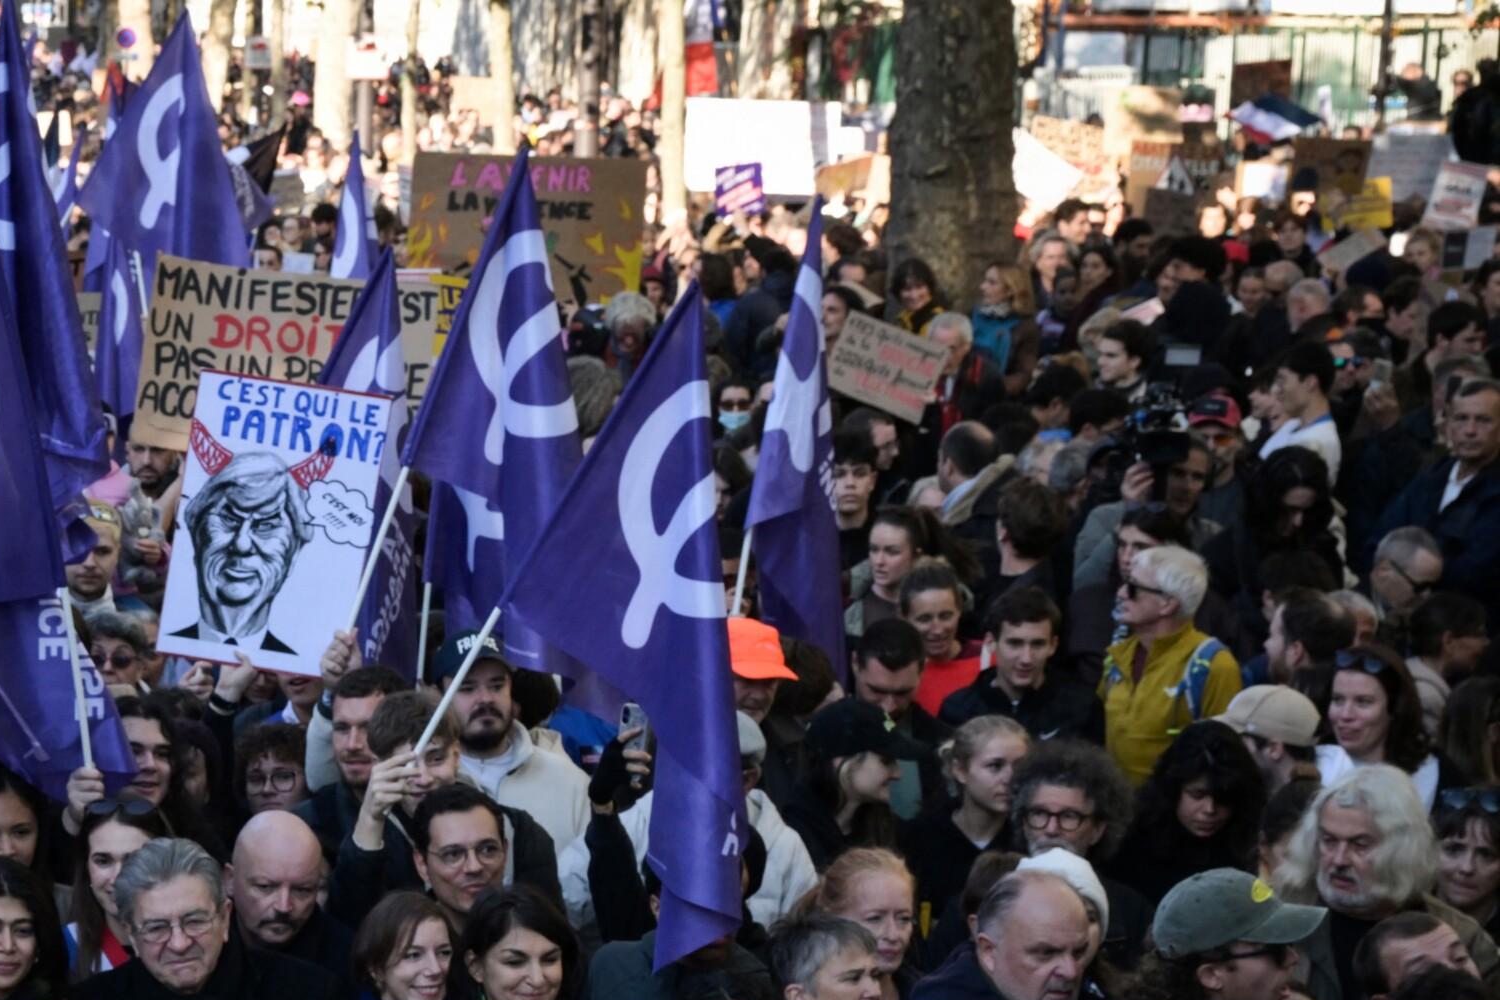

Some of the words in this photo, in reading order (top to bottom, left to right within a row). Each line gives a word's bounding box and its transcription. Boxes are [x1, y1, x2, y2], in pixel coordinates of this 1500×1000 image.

[447, 190, 479, 212] LA
[150, 309, 195, 343] UN
[153, 341, 218, 381] PAS
[218, 376, 285, 411] C'EST
[349, 400, 380, 427] LE
